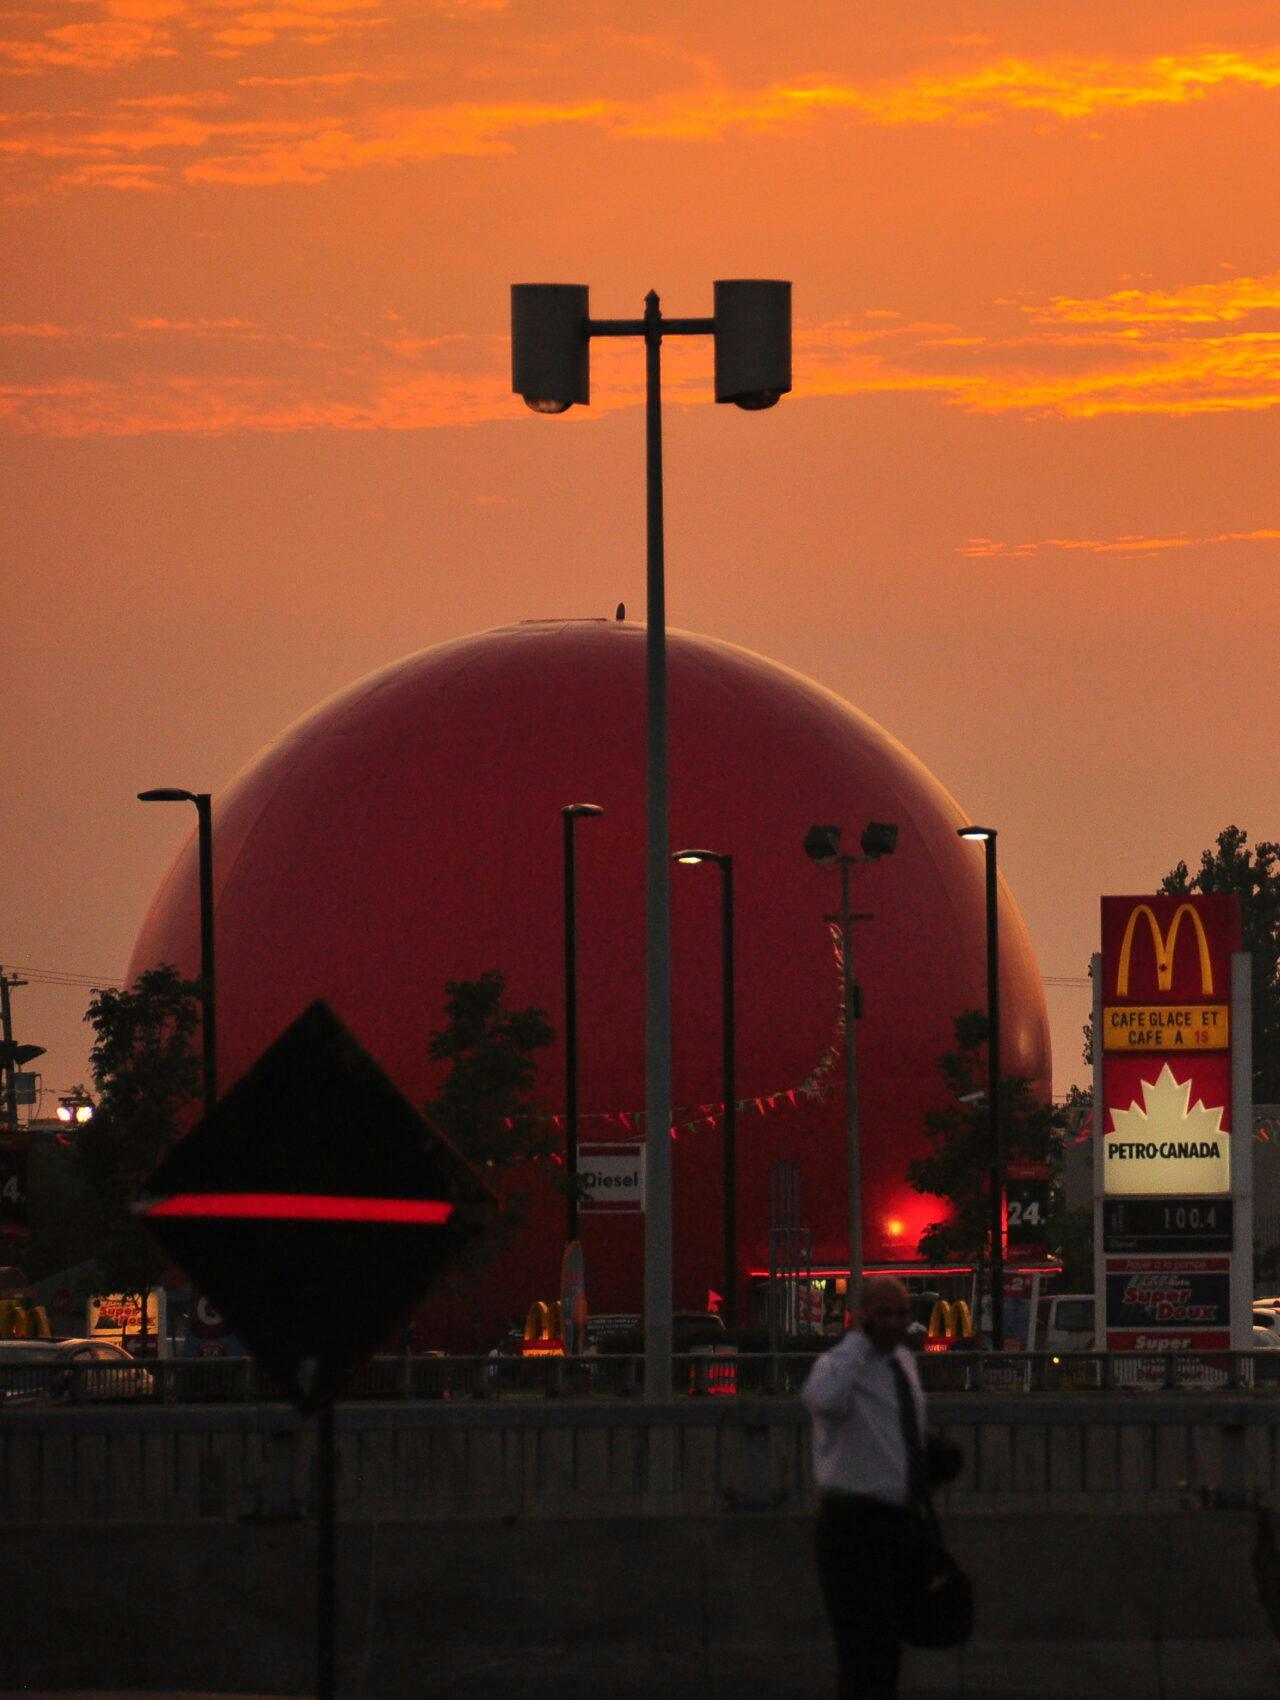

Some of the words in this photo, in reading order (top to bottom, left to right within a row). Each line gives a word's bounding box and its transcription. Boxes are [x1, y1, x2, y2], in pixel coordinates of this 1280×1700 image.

[1111, 1012, 1145, 1027] CAFE
[1149, 1012, 1192, 1027] GLACE
[1202, 1011, 1218, 1026] ET
[1128, 1030, 1163, 1045] CAFE
[1174, 1030, 1183, 1044] A
[584, 1171, 638, 1188] Diesel
[1164, 1207, 1216, 1229] 100.4
[1123, 1287, 1192, 1306] Super
[1135, 1336, 1191, 1352] Super
